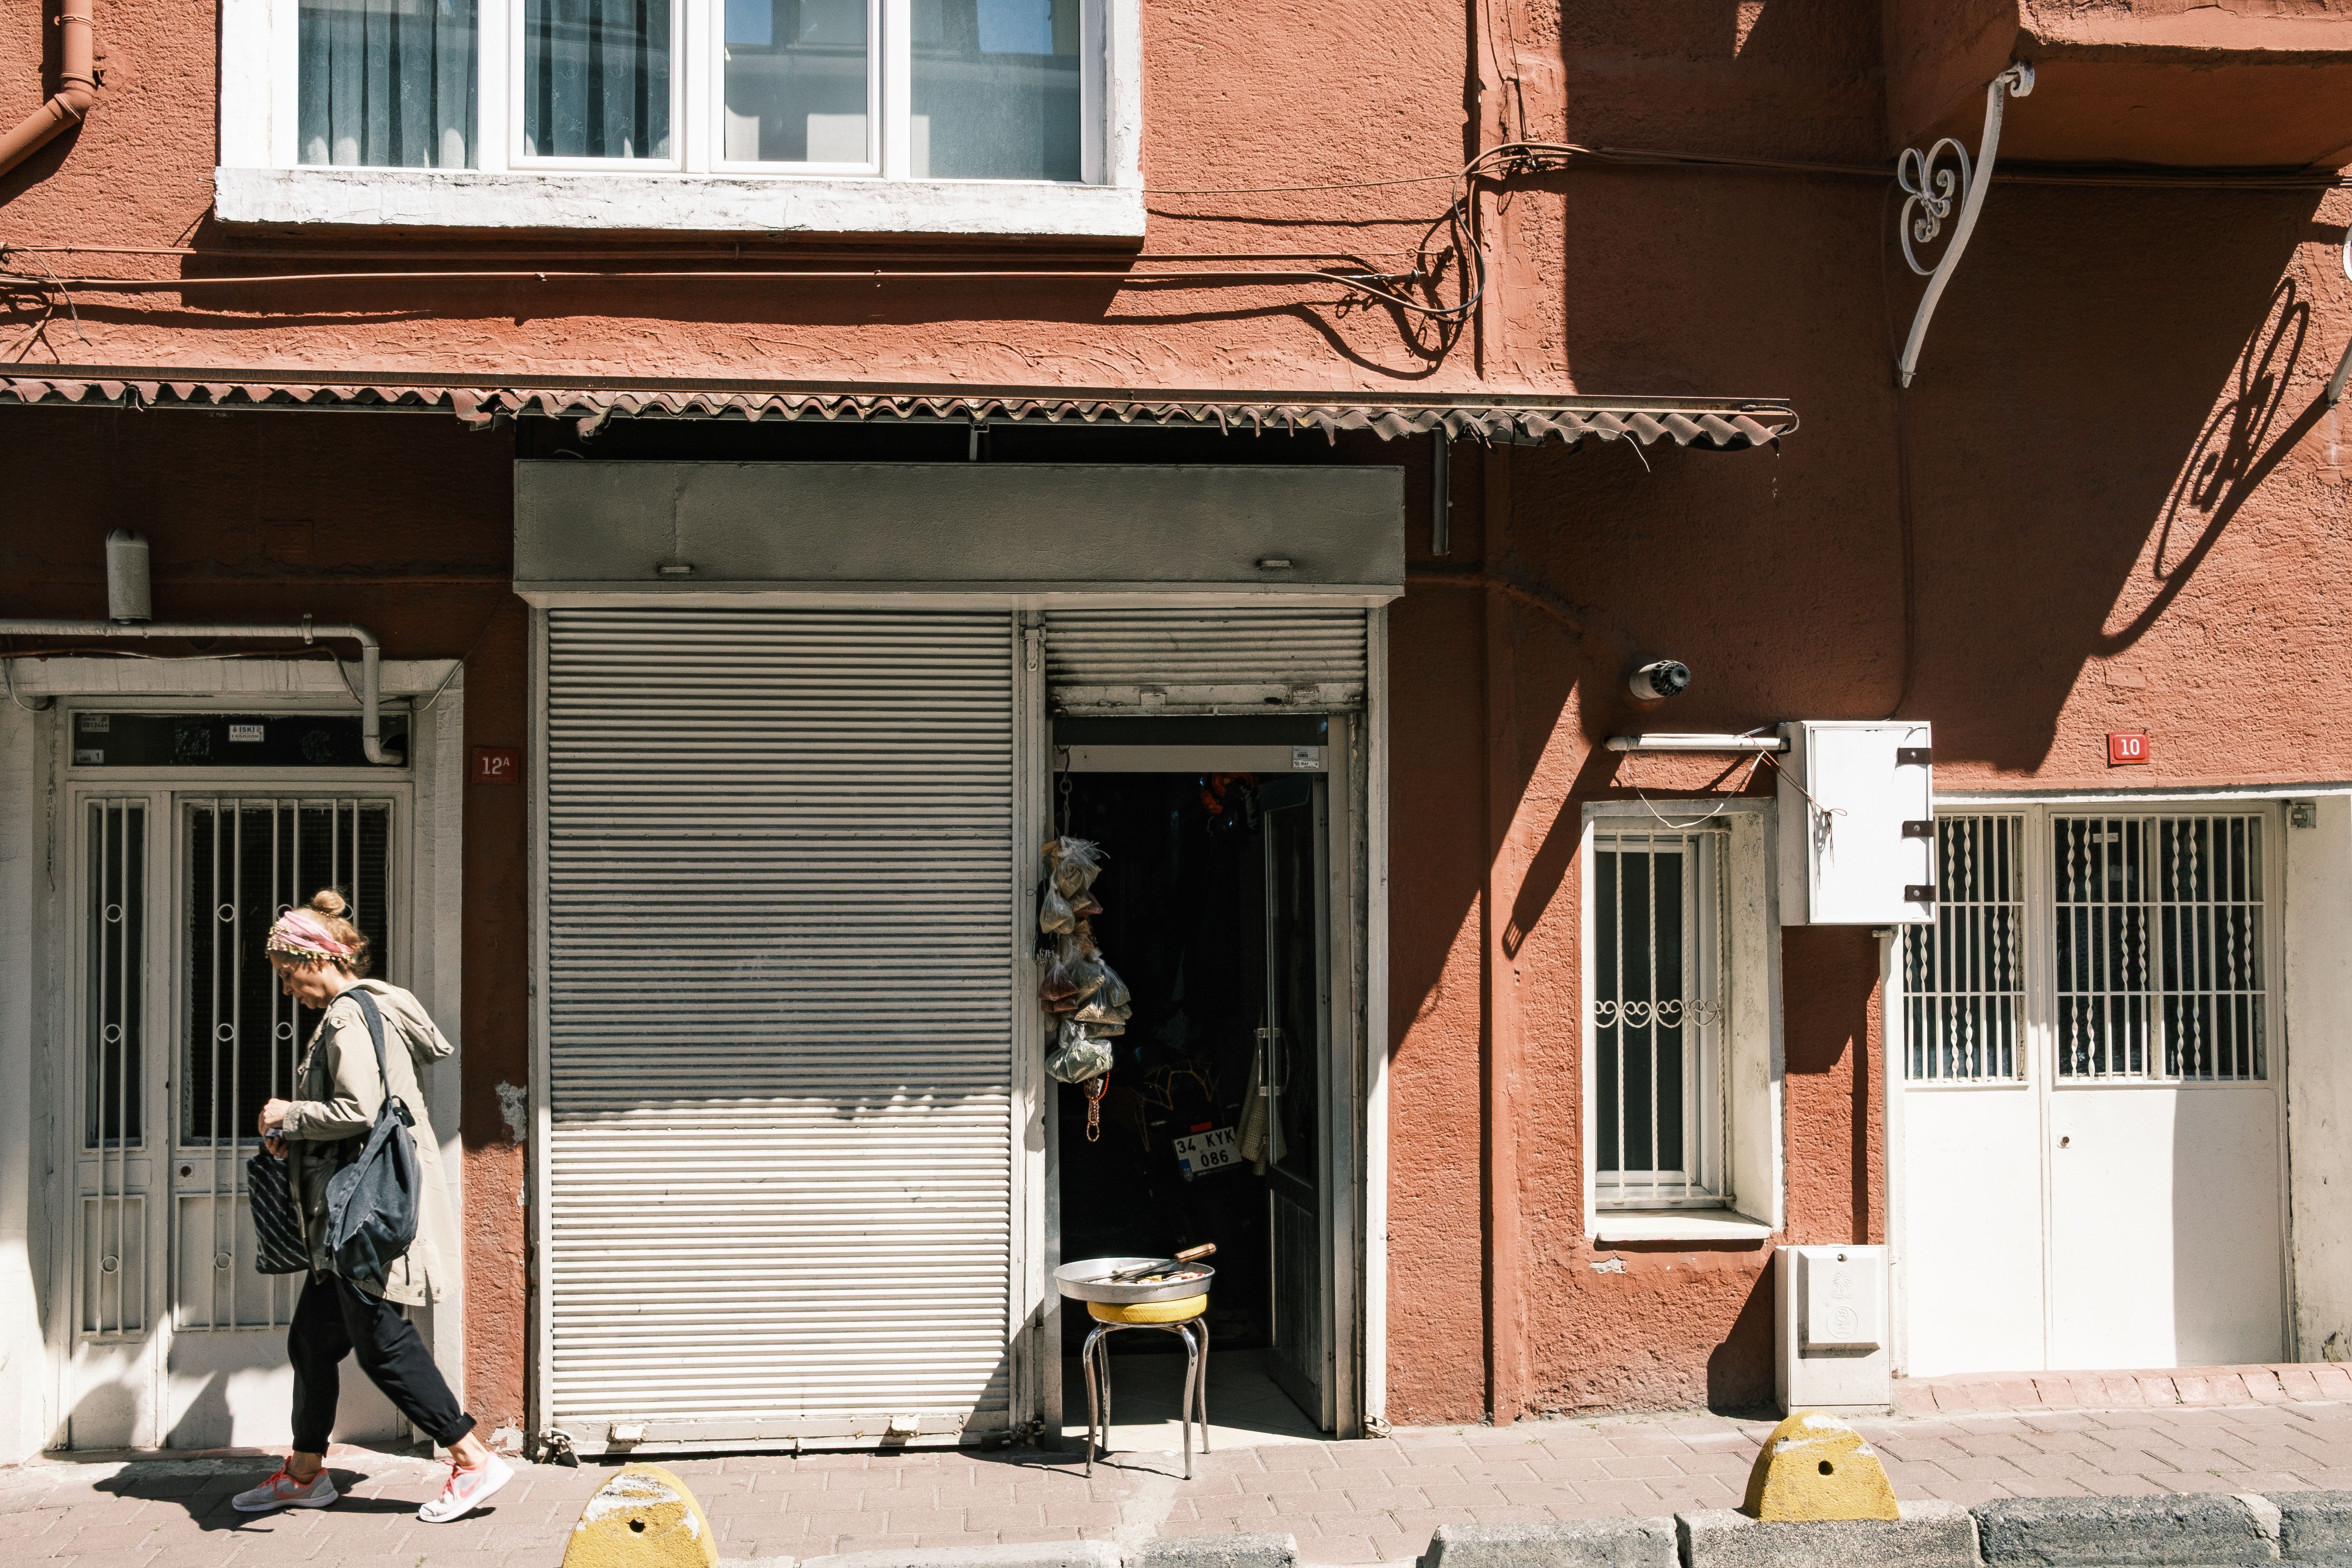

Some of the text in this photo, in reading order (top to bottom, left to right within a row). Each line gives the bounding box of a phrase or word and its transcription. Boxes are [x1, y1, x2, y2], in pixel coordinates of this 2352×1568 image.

[2121, 739, 2140, 756] 10
[482, 757, 510, 774] 12A
[1177, 1129, 1234, 1153] 34 KYK
[1200, 1150, 1229, 1167] 086
